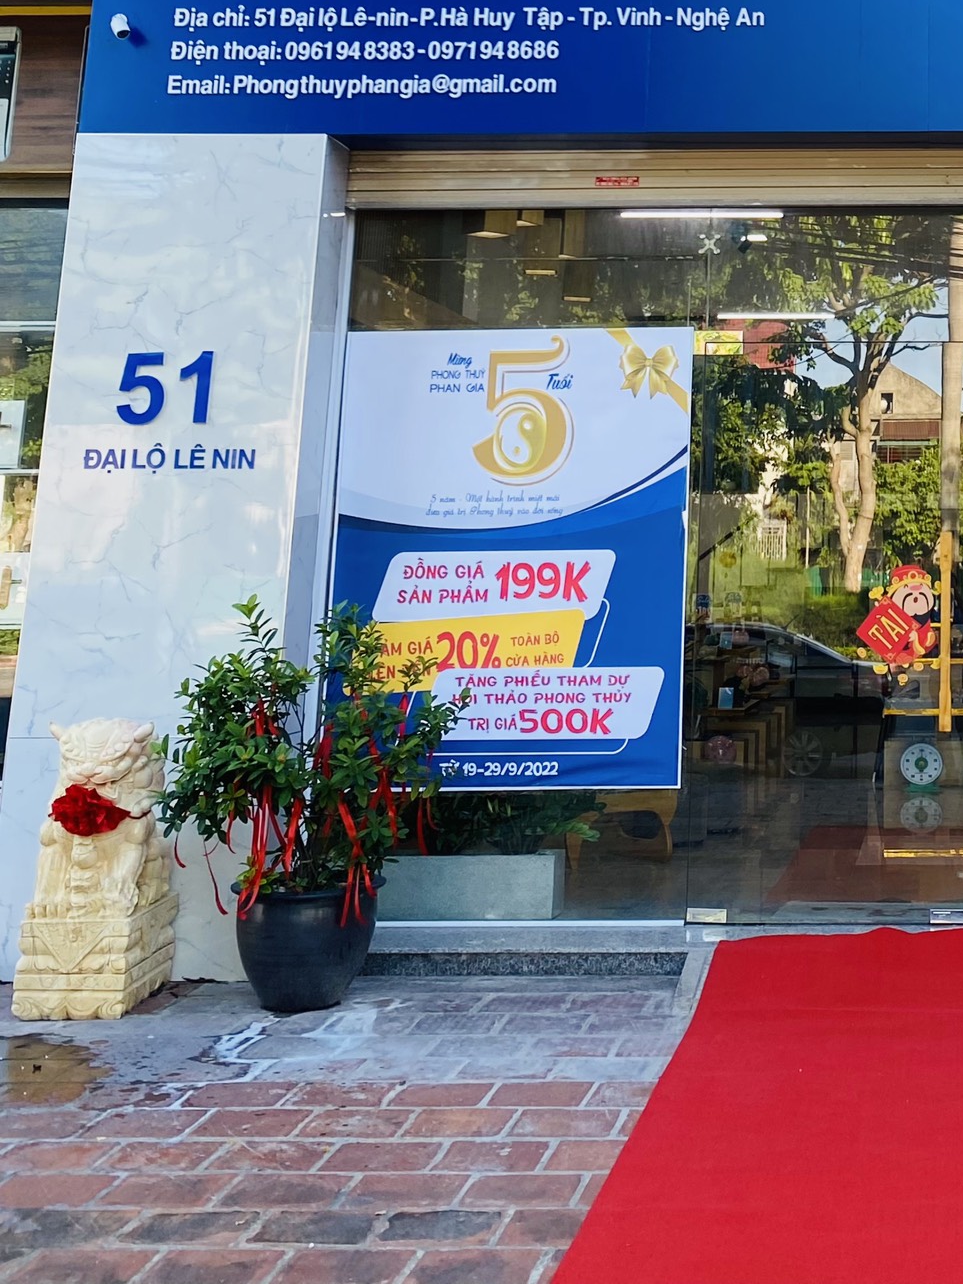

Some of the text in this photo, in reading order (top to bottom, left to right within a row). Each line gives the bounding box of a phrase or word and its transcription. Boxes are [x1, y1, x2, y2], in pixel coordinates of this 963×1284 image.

[174, 7, 208, 32] Địa
[212, 5, 250, 27] chỉ:
[254, 7, 275, 27] 51
[280, 7, 315, 32] Đại
[318, 7, 338, 32] lộ
[473, 7, 516, 31] Huy
[522, 7, 564, 30] Tập
[579, 7, 612, 30] Tp.
[616, 7, 662, 26] Vinh
[676, 7, 730, 31] Nghệ
[735, 7, 765, 26] An
[171, 40, 218, 65] Điện
[430, 370, 462, 380] PHONG
[116, 350, 215, 427] 51
[429, 383, 485, 393] PHAN GIA
[472, 334, 573, 483] 5
[83, 442, 257, 475] ĐẠI LỘ LÊ NIN
[403, 558, 485, 580] ĐỒNG GIÁ
[396, 581, 489, 605] SẢN PHẨM
[494, 561, 592, 603] 199K
[510, 631, 560, 647] TOÀN BỘ
[867, 607, 911, 651] TÀI
[408, 636, 434, 655] GIÁ
[436, 631, 501, 673] 20%
[534, 651, 565, 665] HÀNG
[504, 670, 551, 687] PHIẾU
[557, 674, 602, 687] THAM
[608, 674, 630, 690] DỰ
[484, 689, 528, 704] THẢO
[533, 692, 586, 704] PHONG
[467, 708, 614, 735] TRỊ GIÁ 500K
[462, 761, 559, 777] 19-29/9/2022
